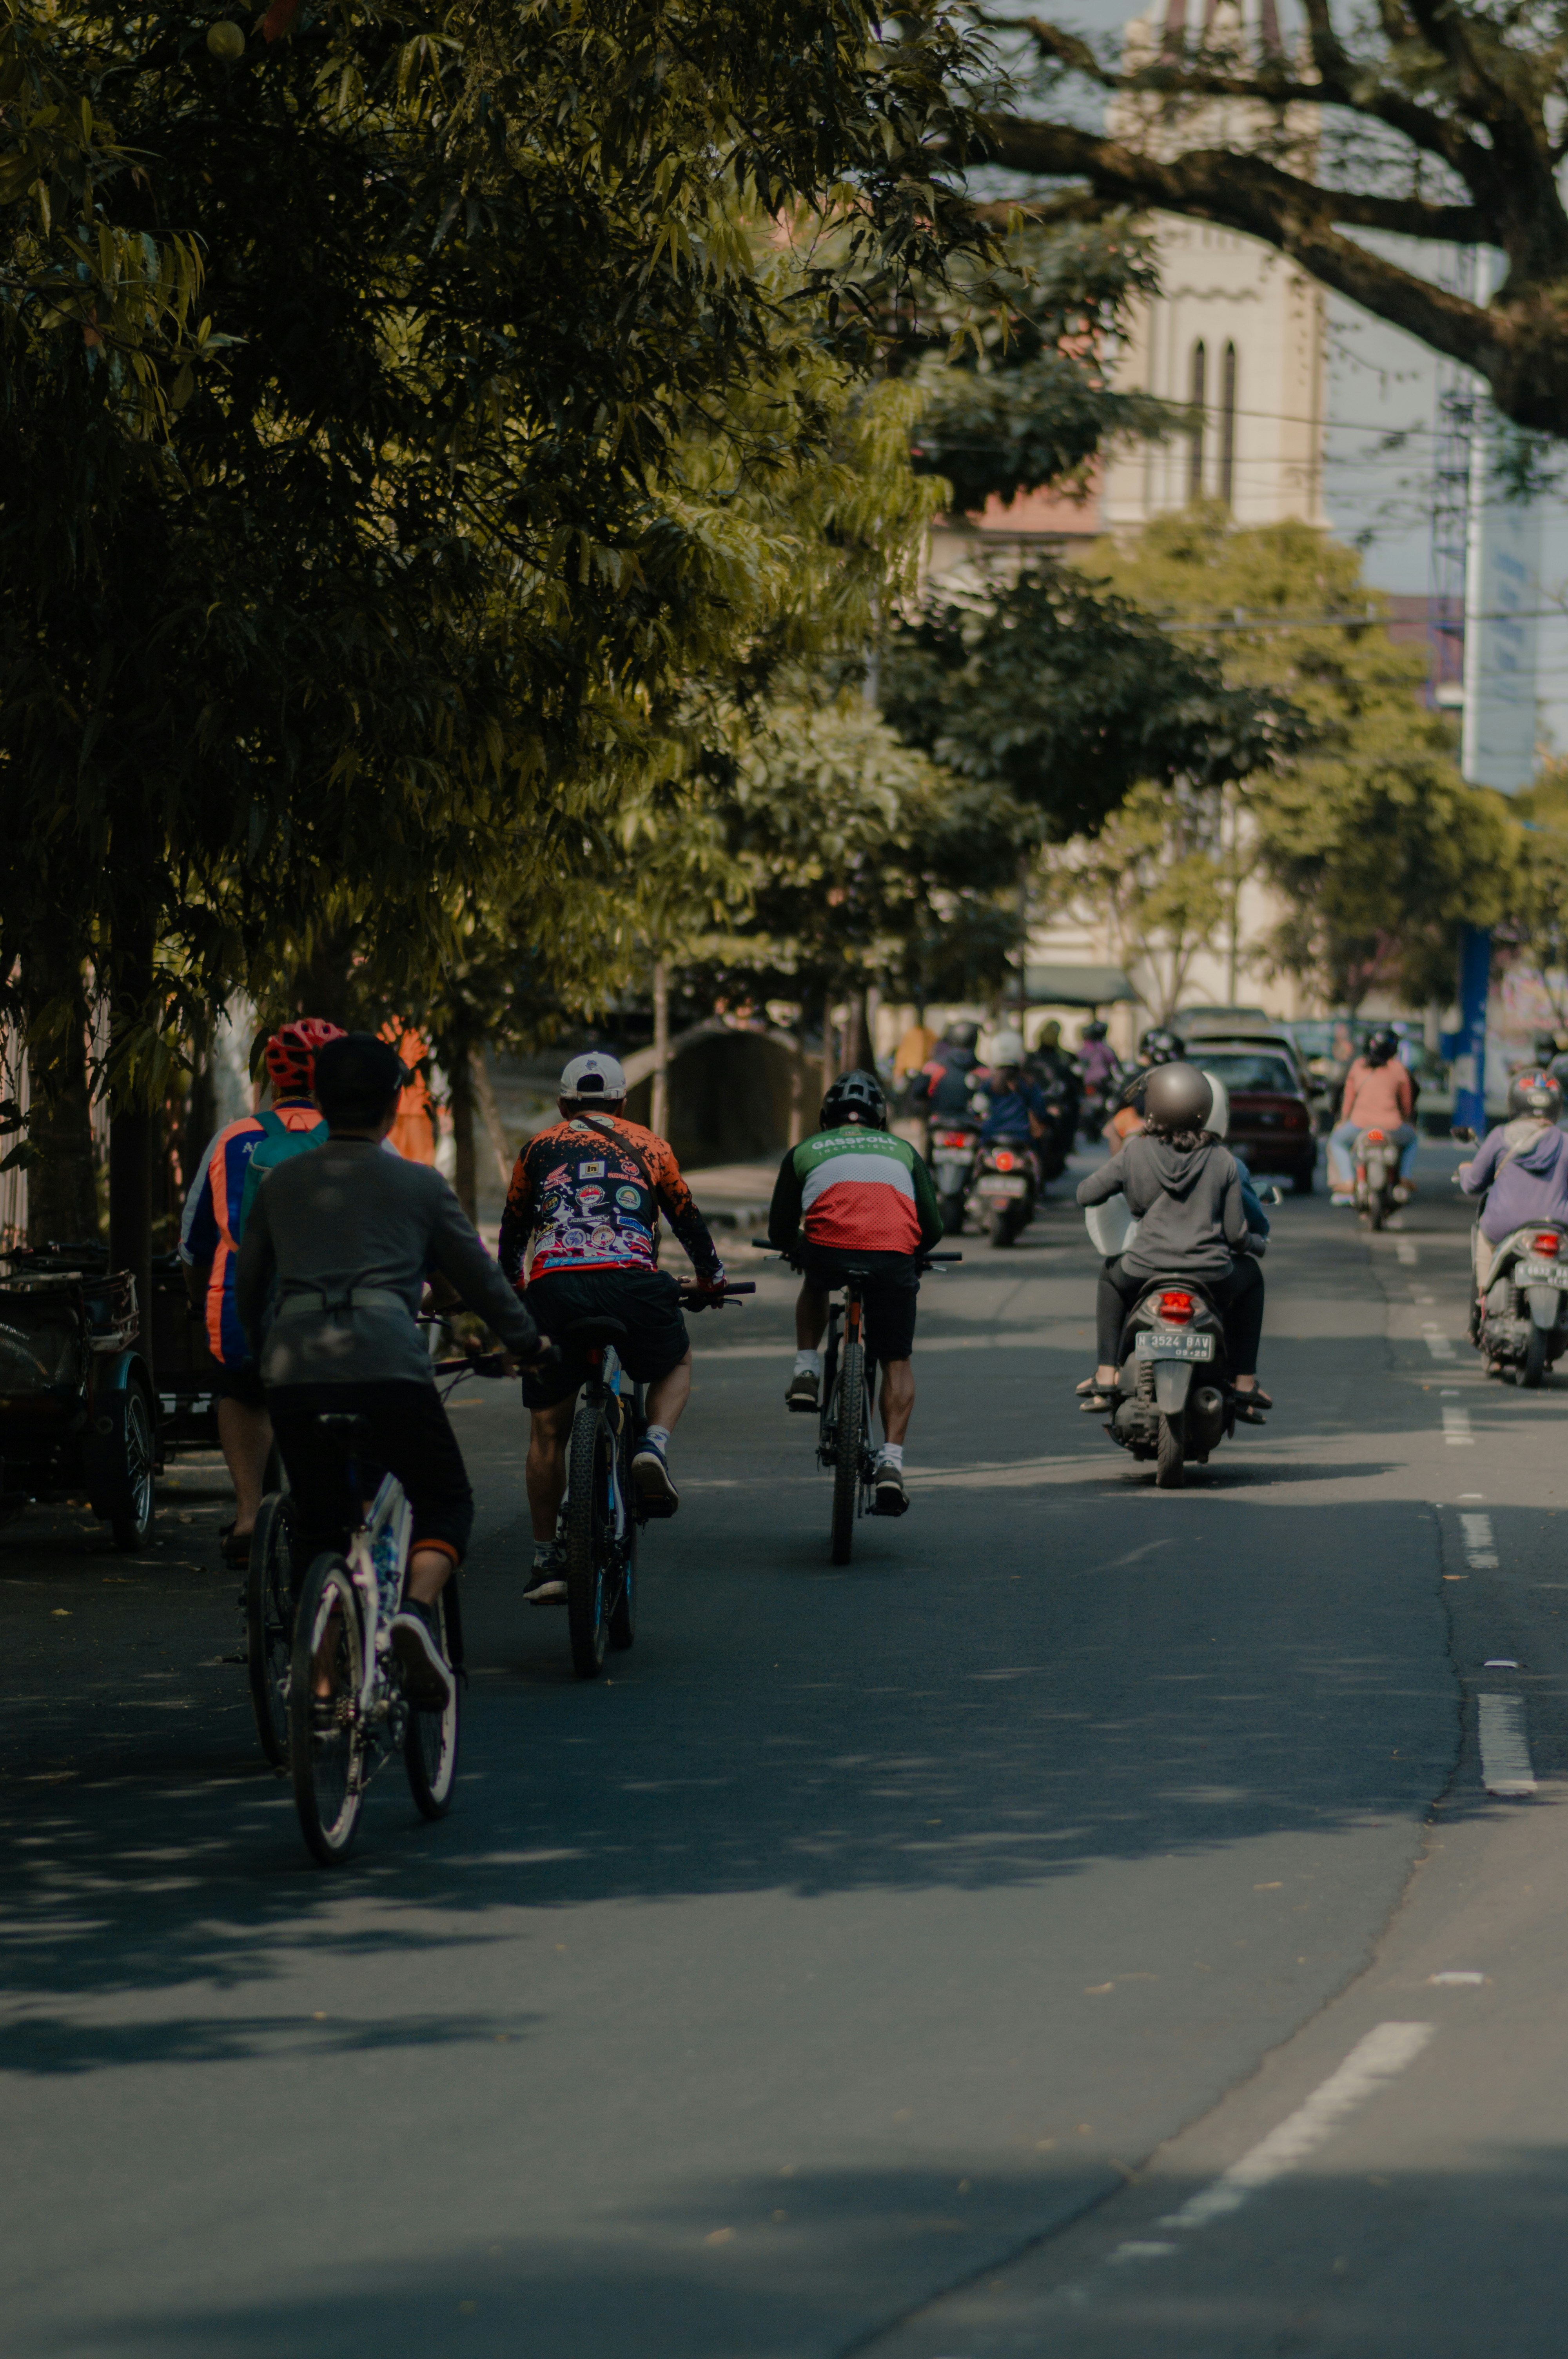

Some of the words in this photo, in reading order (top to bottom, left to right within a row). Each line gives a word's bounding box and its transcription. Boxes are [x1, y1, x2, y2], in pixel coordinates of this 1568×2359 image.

[812, 1137, 897, 1150] GASSPOLL
[819, 1144, 894, 1156] INCREDIBLE
[1138, 1336, 1145, 1346] N
[1151, 1336, 1180, 1347] 3524
[1186, 1337, 1209, 1349] BAV
